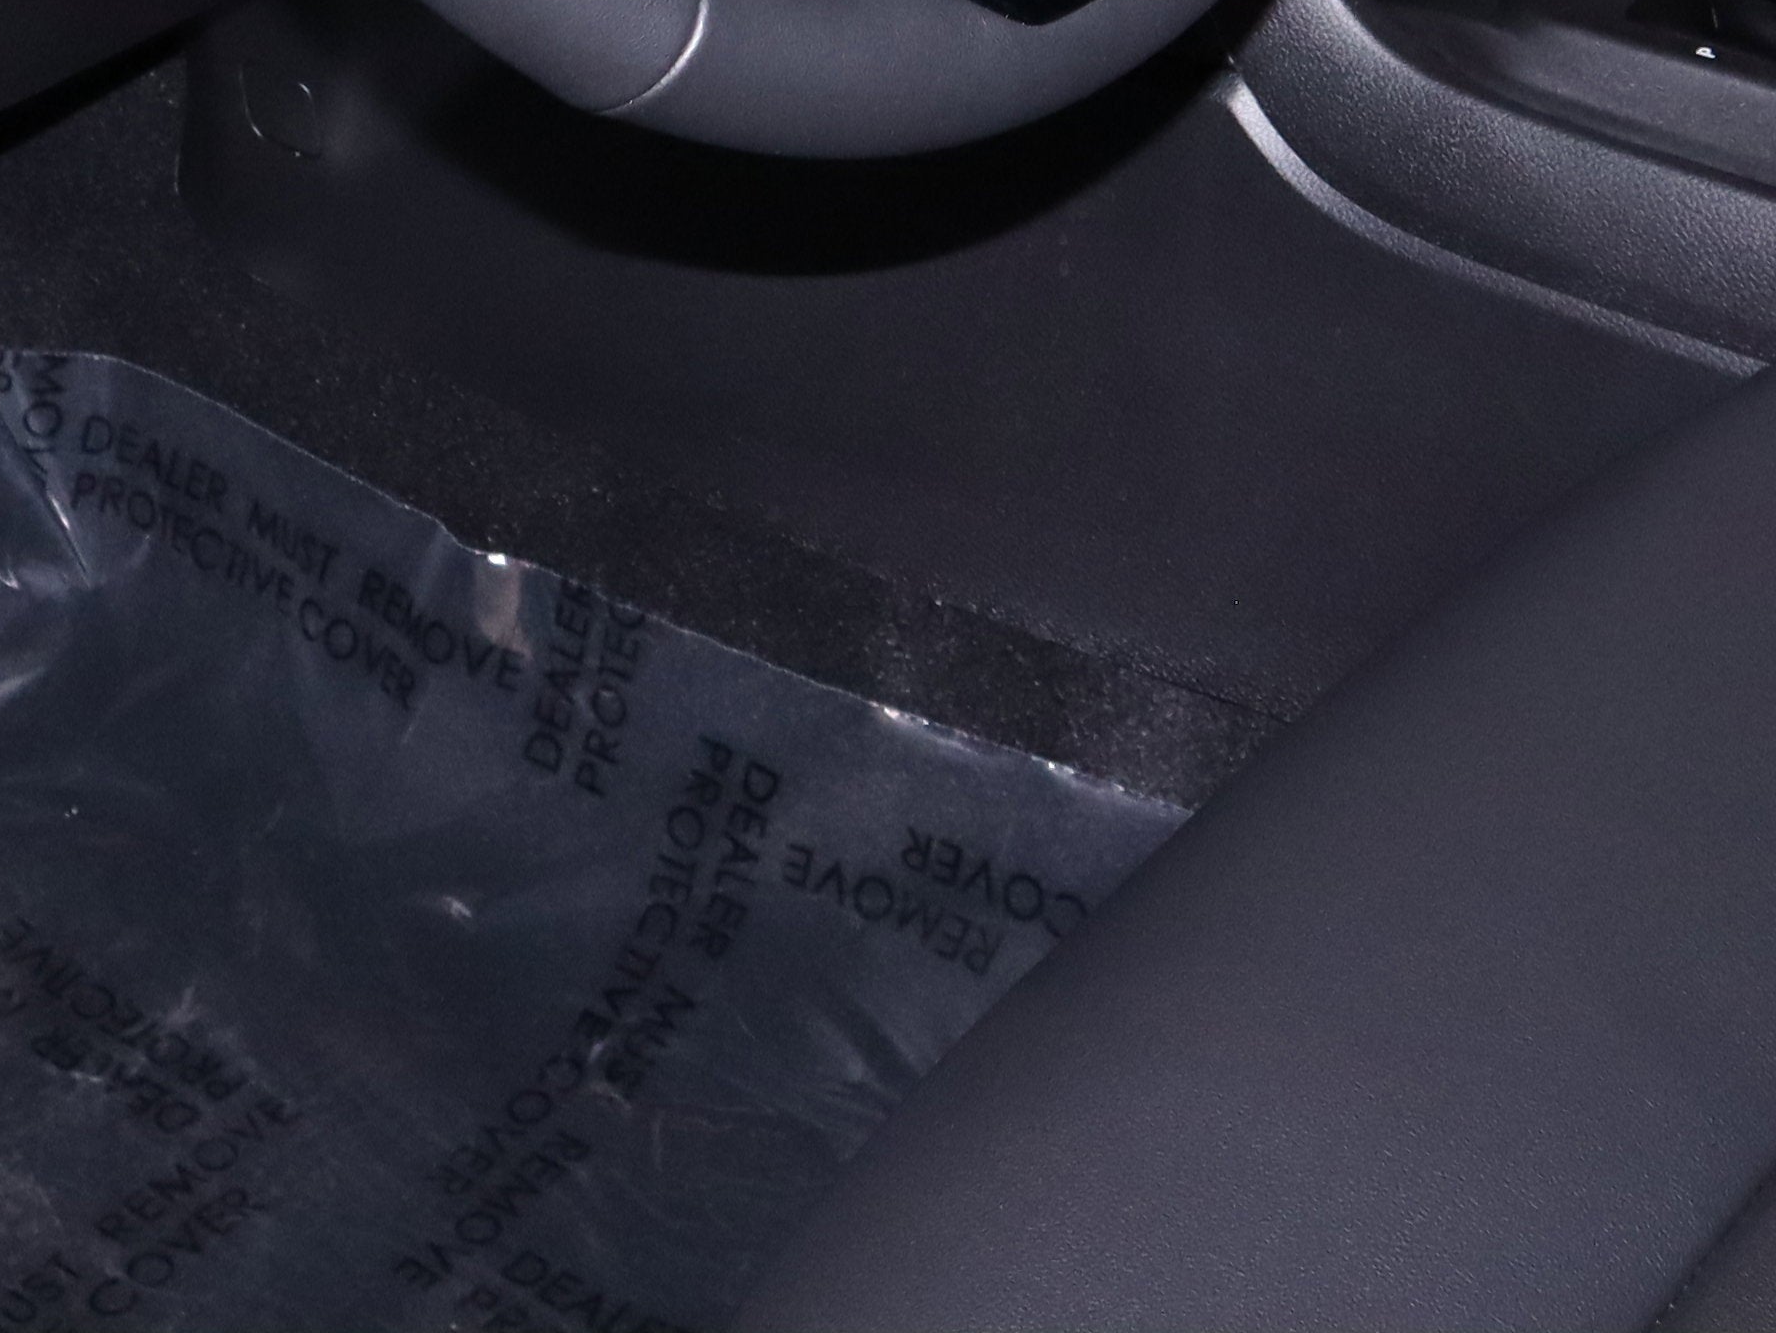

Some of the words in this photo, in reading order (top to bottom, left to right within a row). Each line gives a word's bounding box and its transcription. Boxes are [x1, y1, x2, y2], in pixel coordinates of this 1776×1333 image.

[1695, 46, 1717, 60] P
[71, 471, 296, 617] PROTECTIVE
[297, 599, 422, 712] COVER
[80, 414, 229, 511] DEALER
[245, 501, 341, 582] MUST
[356, 568, 523, 694] REMOVE
[523, 579, 593, 776] DEALER
[692, 757, 783, 963] DEALER
[782, 840, 1001, 978] REMOVE
[899, 826, 1087, 938] COVER
